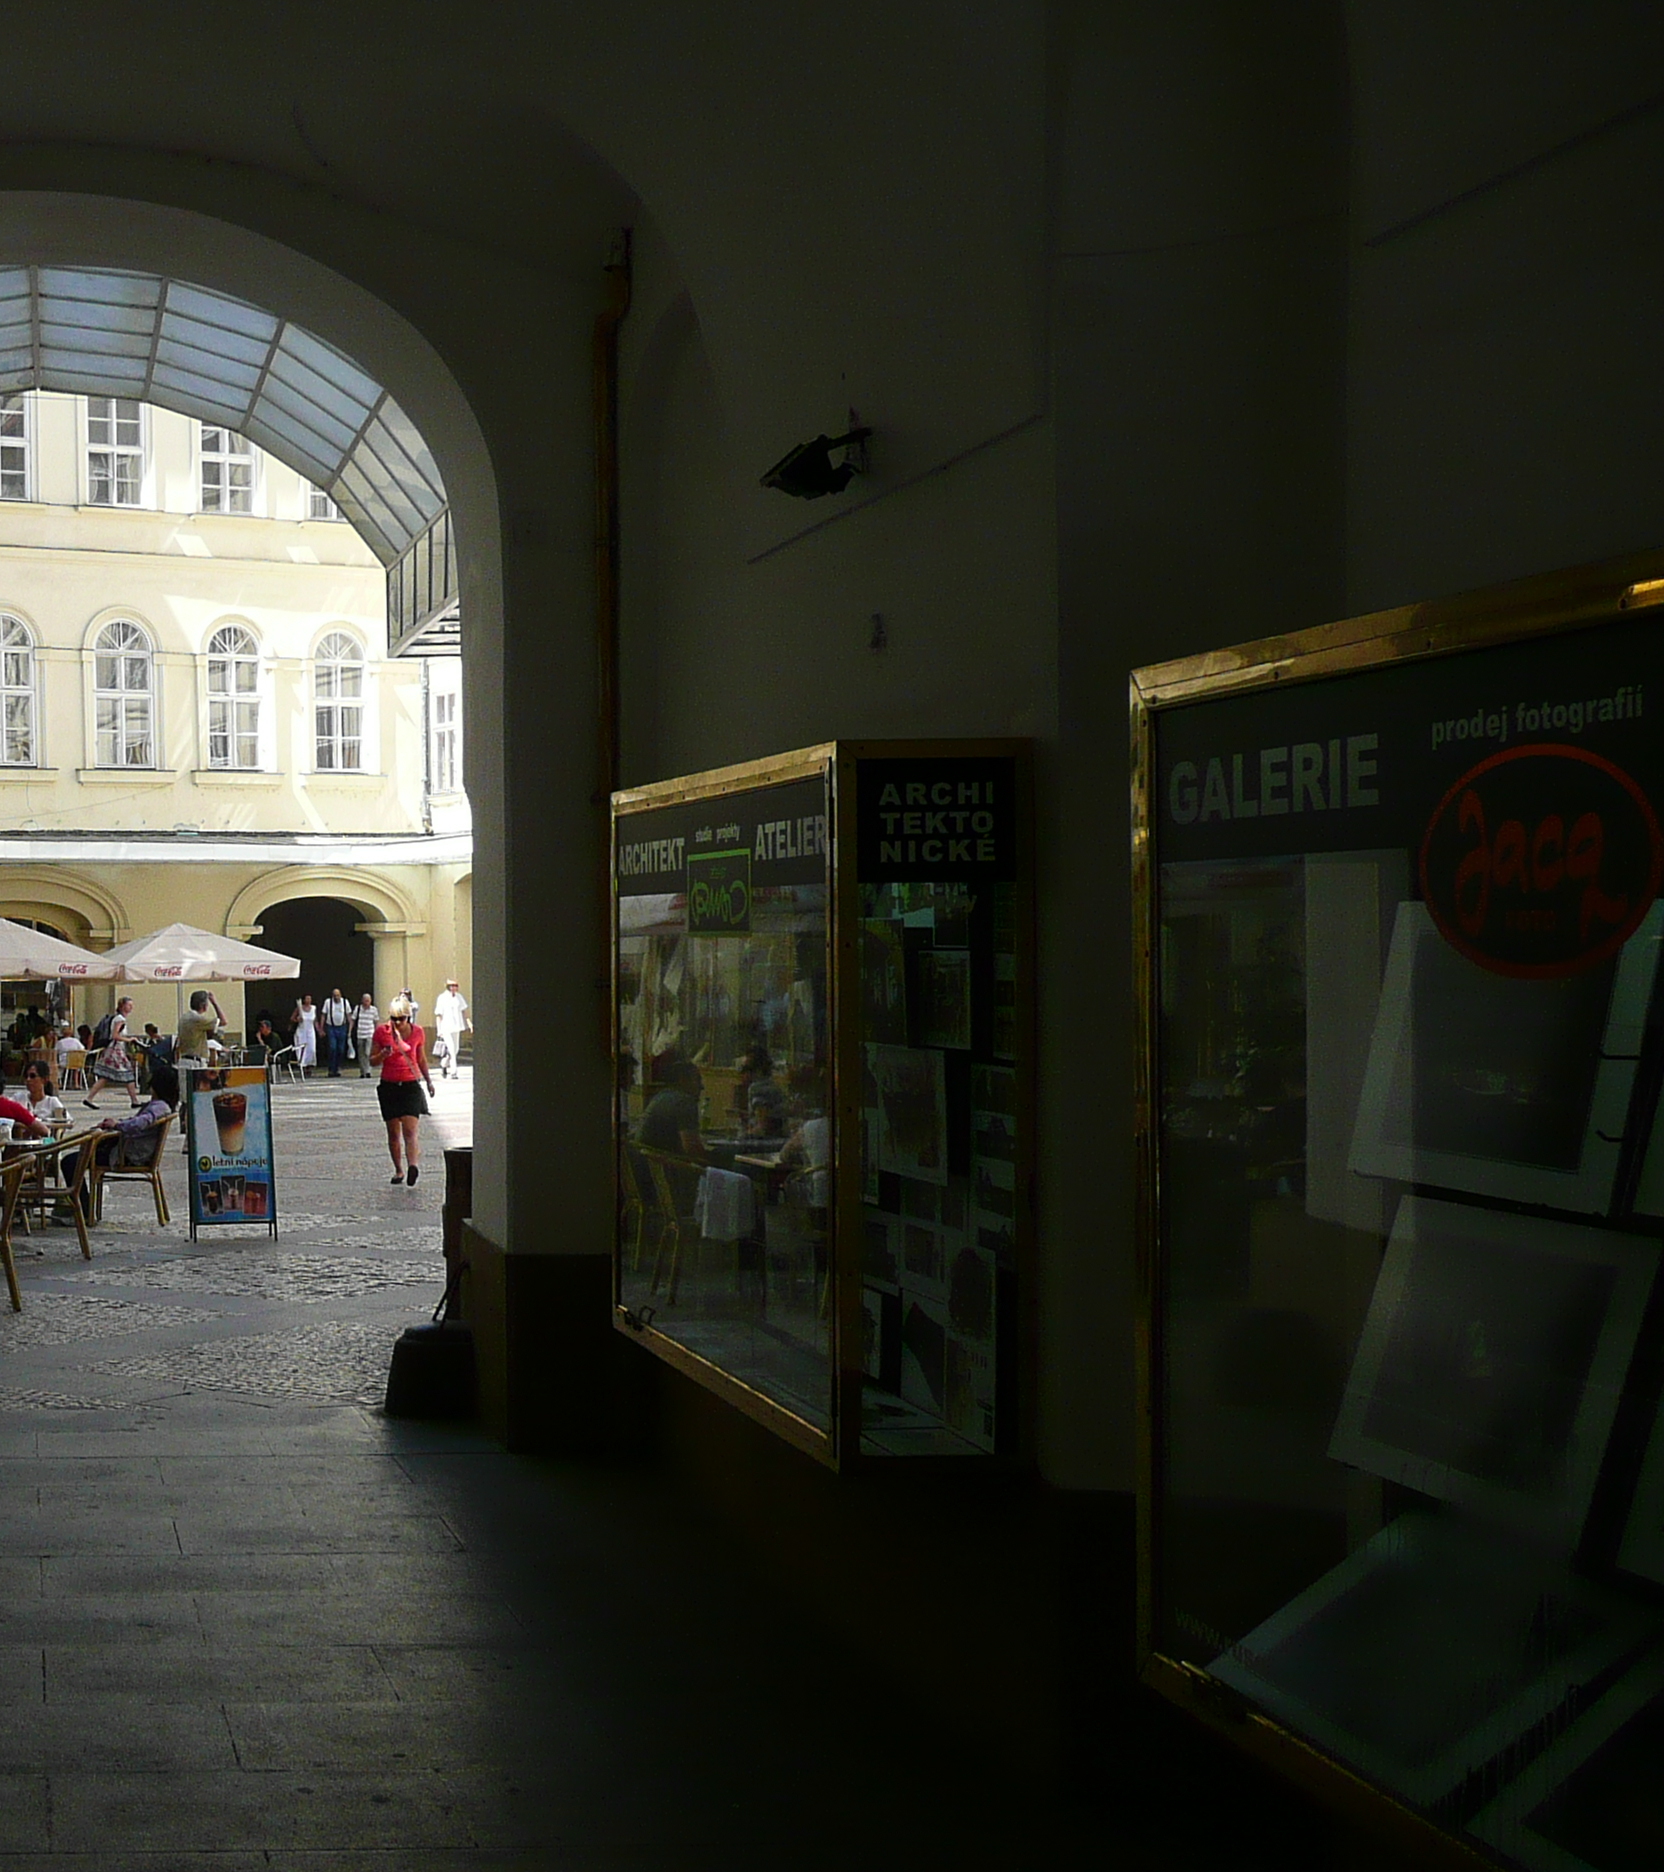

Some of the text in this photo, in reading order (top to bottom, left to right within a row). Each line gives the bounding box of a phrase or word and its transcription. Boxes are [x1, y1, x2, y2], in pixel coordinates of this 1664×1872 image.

[1431, 683, 1644, 750] prodej fotografií
[879, 780, 994, 806] ARCHI
[1168, 732, 1379, 825] GALERIE
[755, 815, 826, 861] ATELIER
[879, 809, 994, 835] TEKTO
[619, 837, 686, 876] ARCHITEKT
[879, 833, 996, 863] NICKÉ
